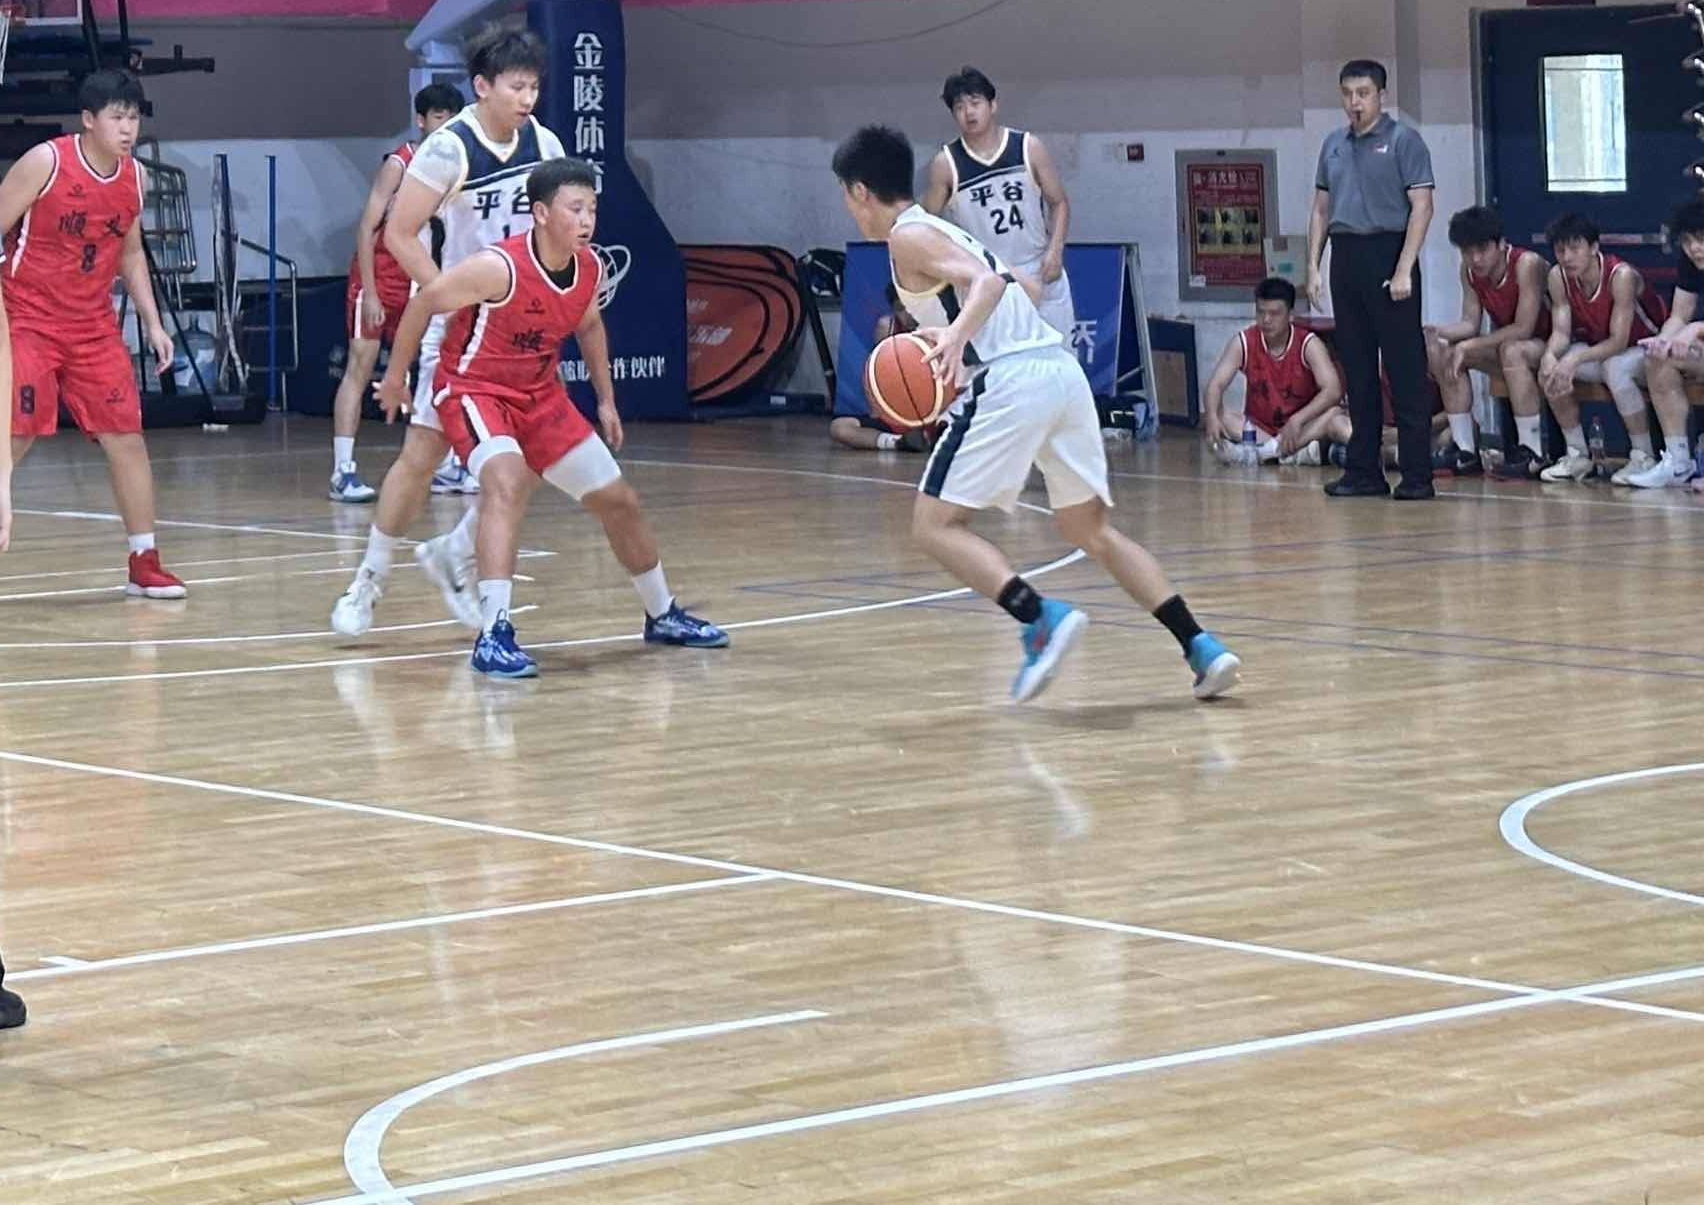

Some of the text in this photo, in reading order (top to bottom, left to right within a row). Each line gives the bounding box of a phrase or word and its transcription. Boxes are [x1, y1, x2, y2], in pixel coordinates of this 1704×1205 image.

[969, 181, 1023, 207] 平谷
[990, 204, 1024, 235] 24
[81, 242, 97, 273] 8
